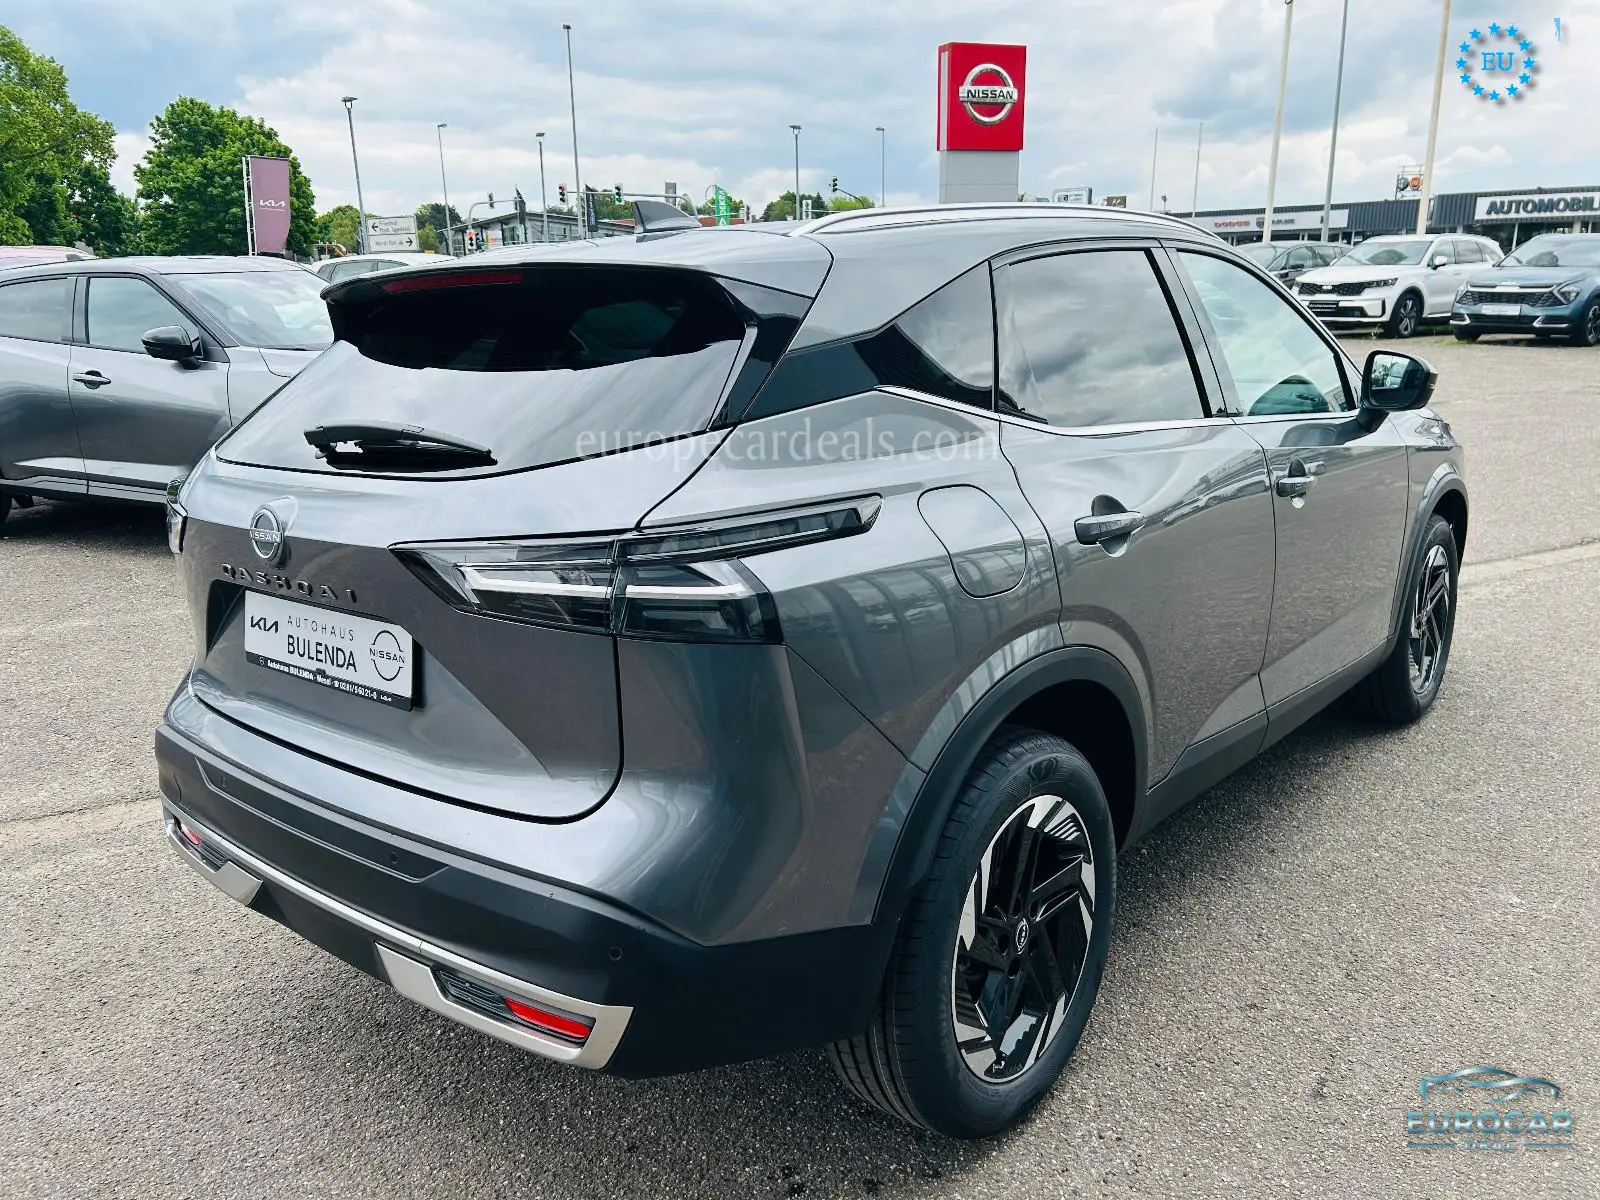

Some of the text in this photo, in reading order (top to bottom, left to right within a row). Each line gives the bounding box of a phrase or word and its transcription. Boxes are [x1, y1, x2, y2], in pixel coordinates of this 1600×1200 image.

[966, 89, 1014, 100] NISSAN
[718, 190, 729, 216] DEKRA
[1486, 195, 1600, 215] AUTOMOBIL
[249, 530, 281, 543] NISSAN
[221, 563, 358, 604] QASHQAI
[287, 615, 355, 642] AUTOHAUS
[287, 634, 358, 673] BULENDA
[369, 647, 405, 664] NISSAN
[289, 665, 314, 681] BULENDA
